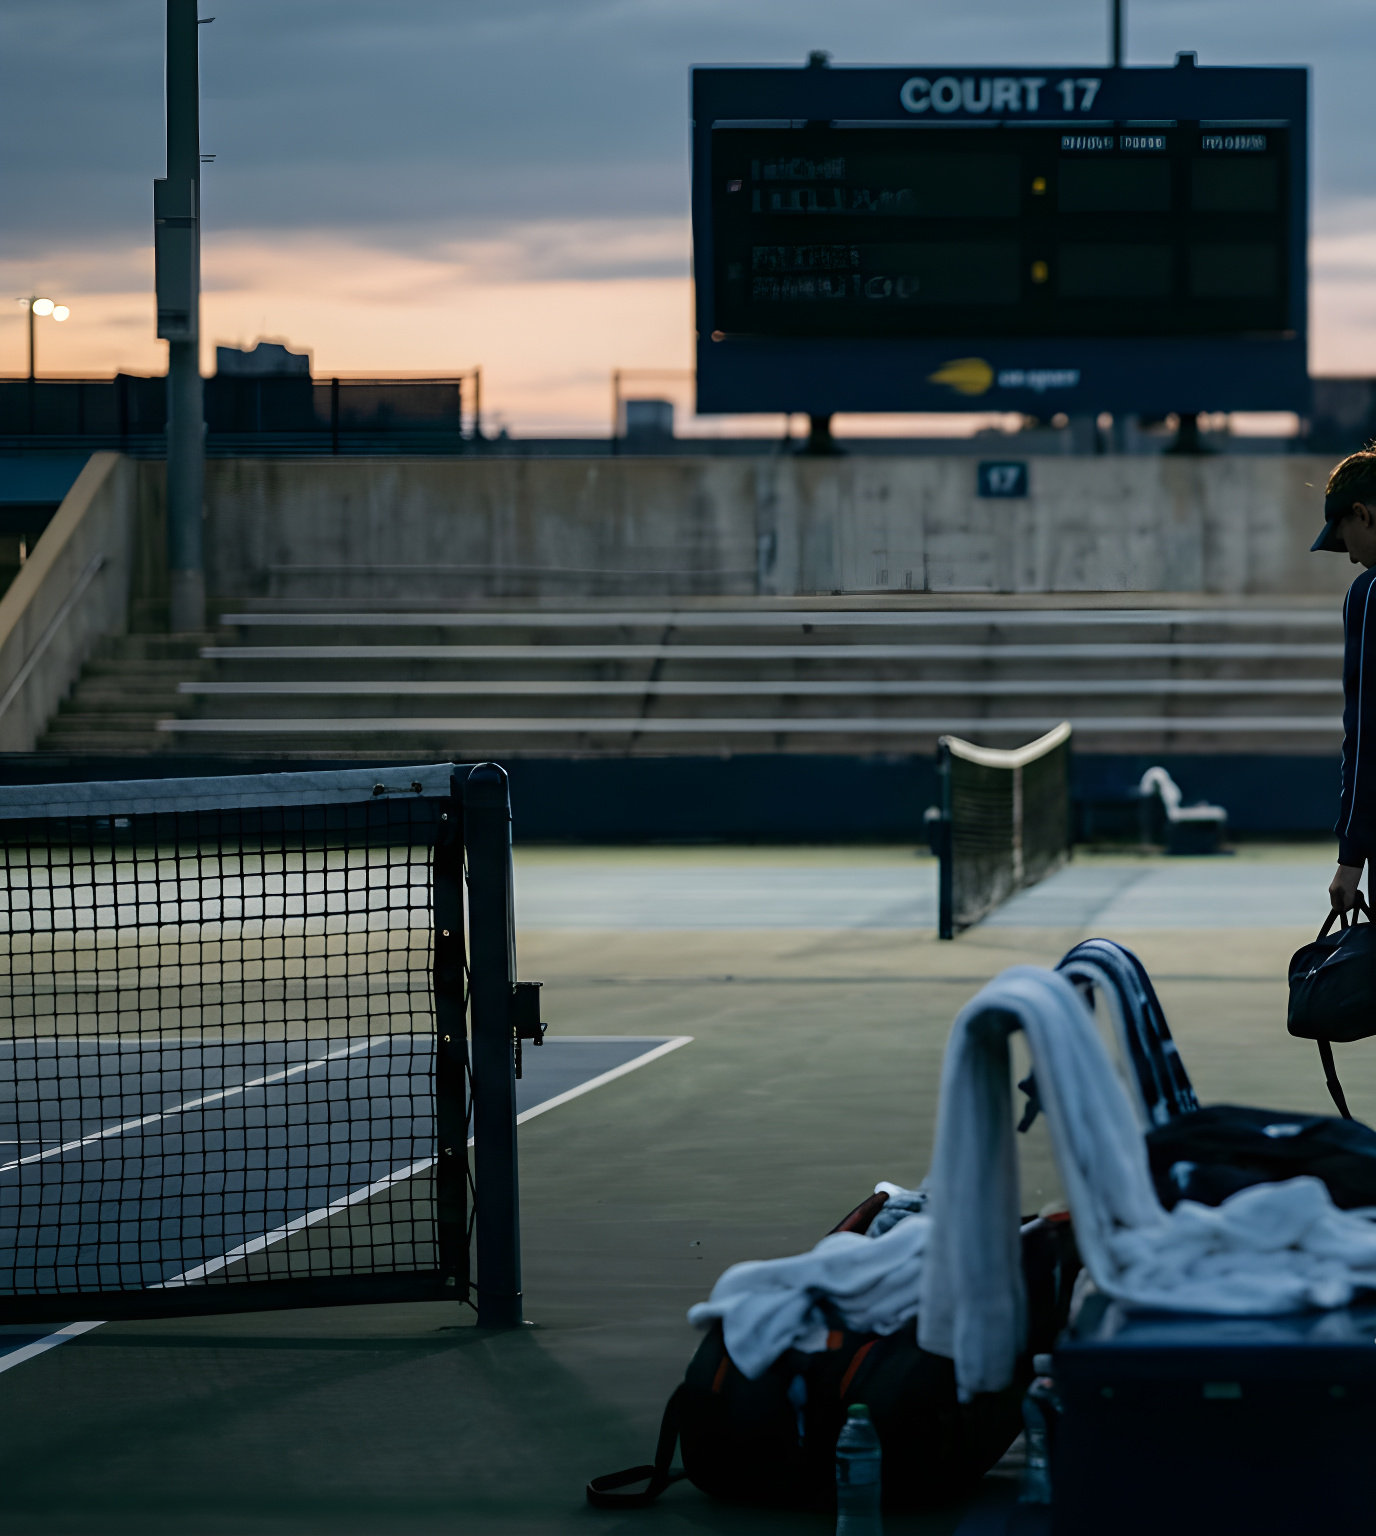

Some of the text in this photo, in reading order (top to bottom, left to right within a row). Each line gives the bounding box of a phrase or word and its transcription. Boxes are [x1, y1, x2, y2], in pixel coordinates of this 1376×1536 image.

[901, 77, 1101, 113] COURT 17
[988, 466, 1020, 493] 17
